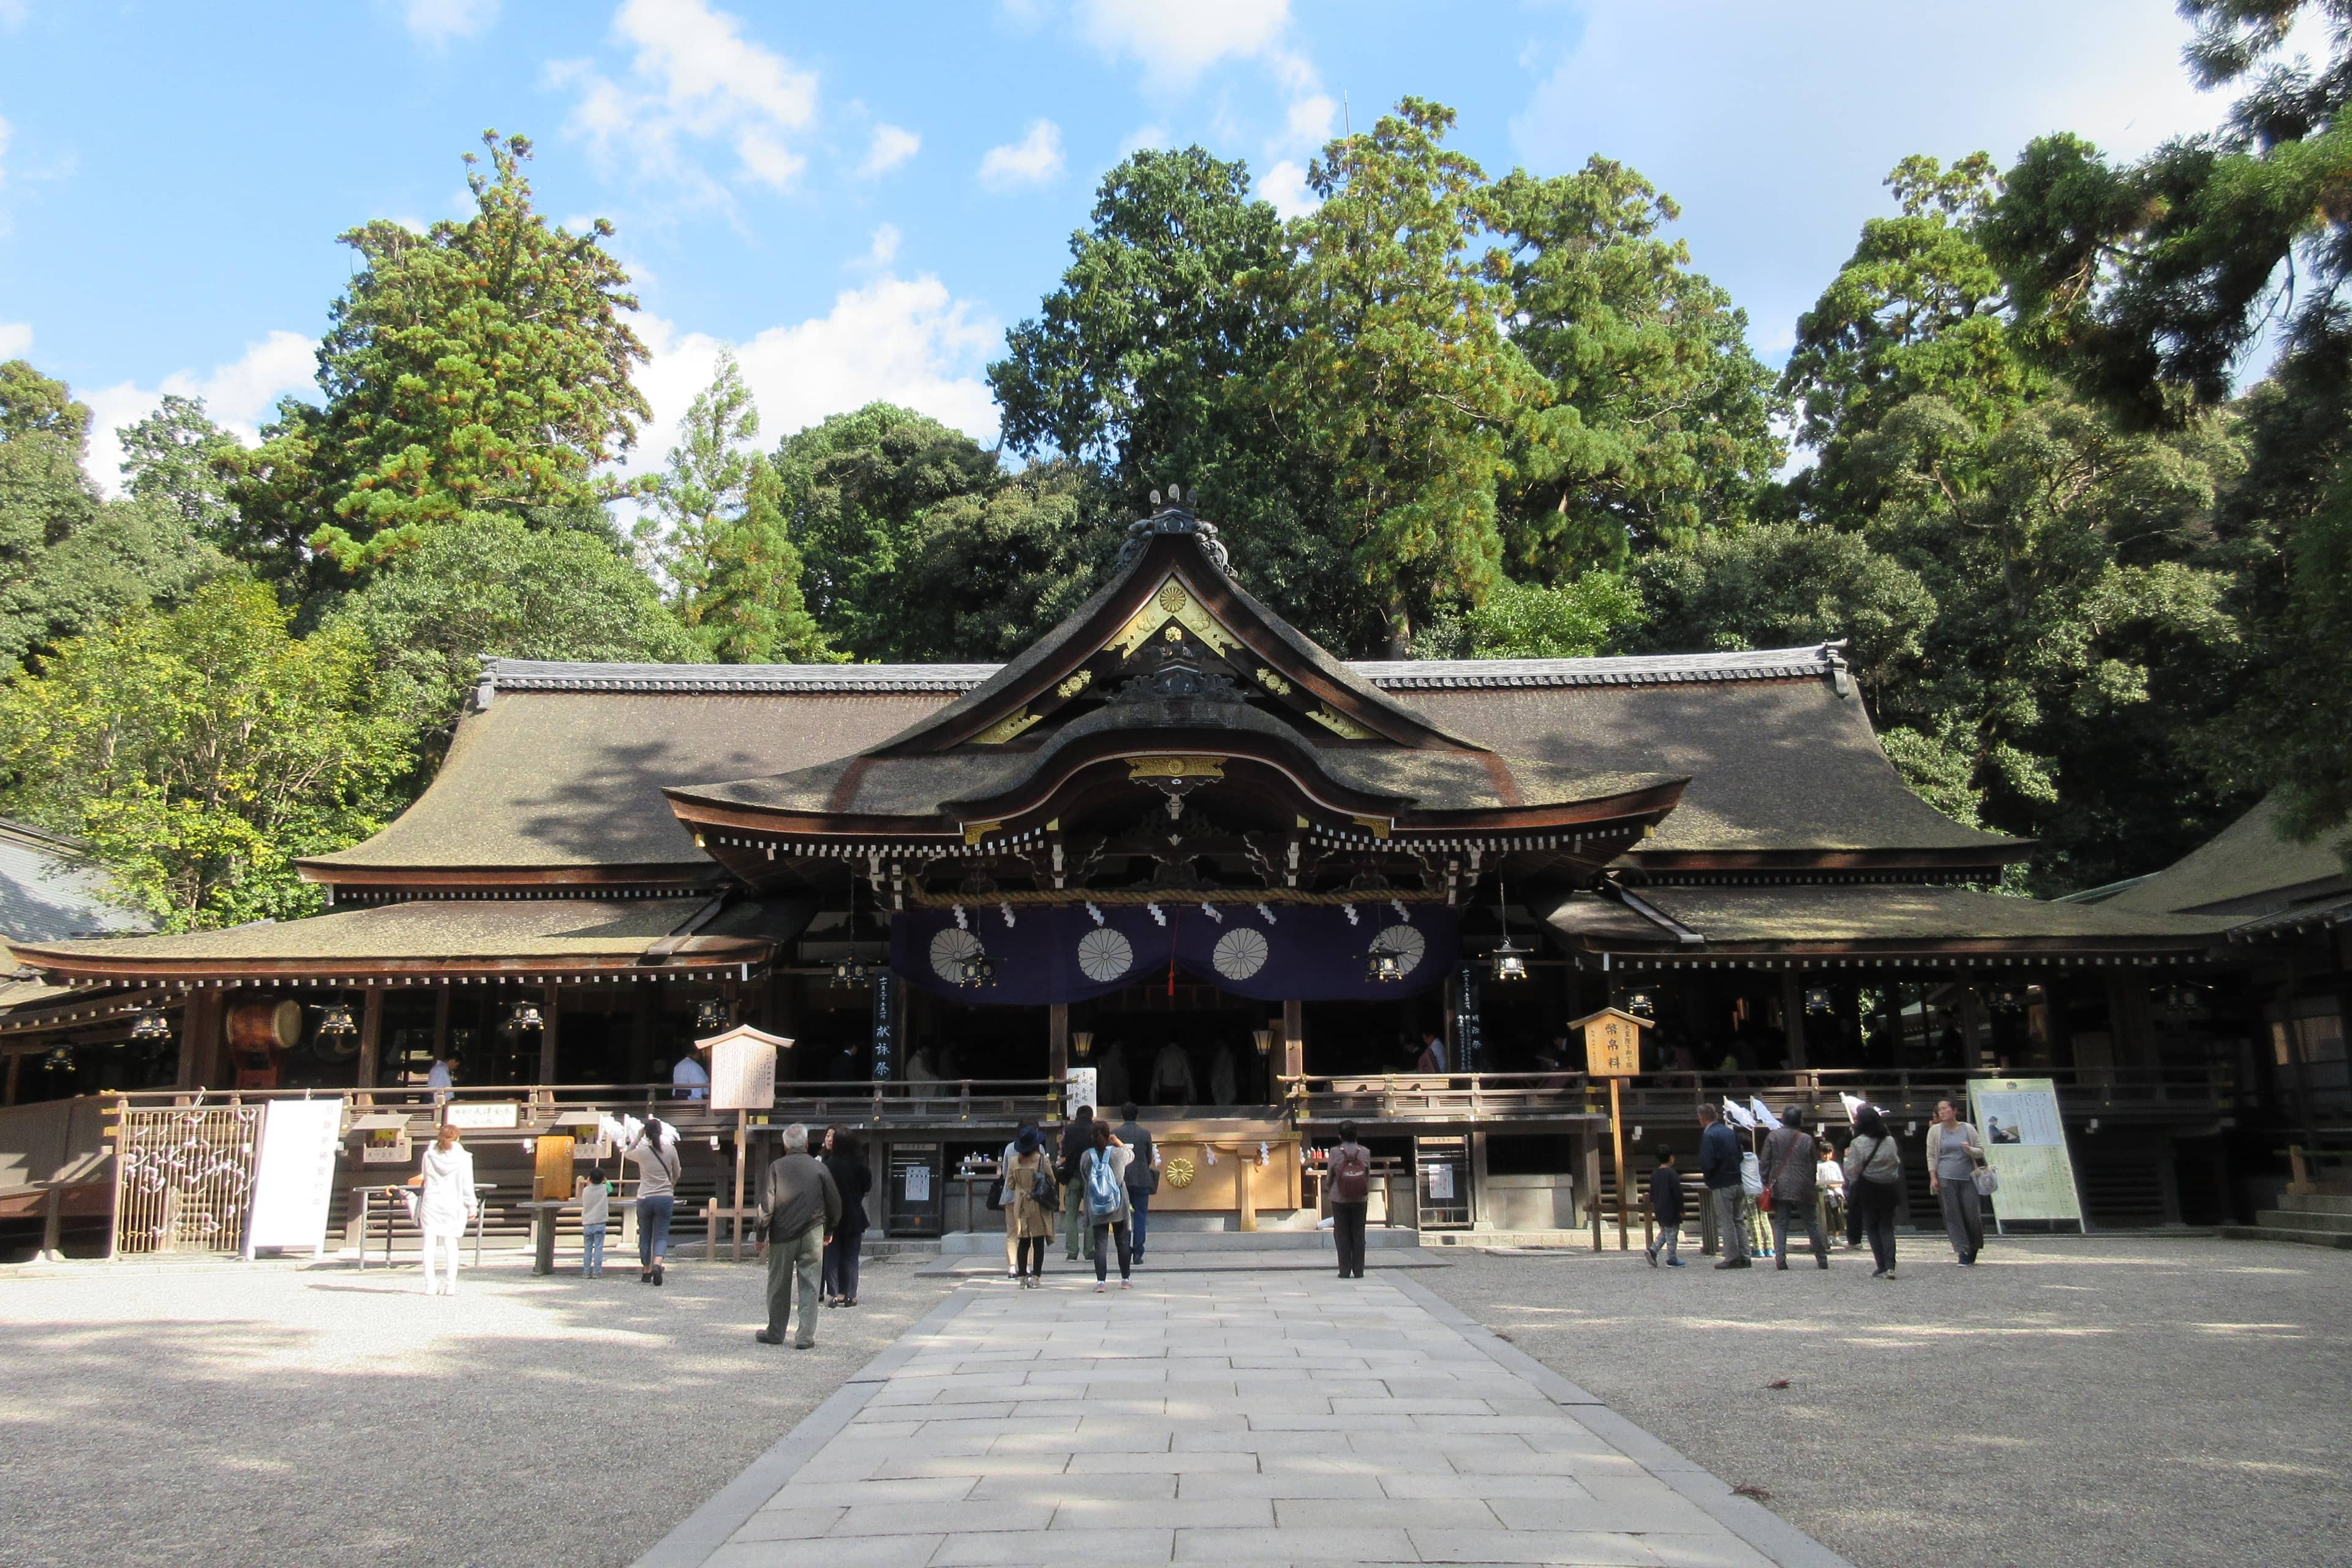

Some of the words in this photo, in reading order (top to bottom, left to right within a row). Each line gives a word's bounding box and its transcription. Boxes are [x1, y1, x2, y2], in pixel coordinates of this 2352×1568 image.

[873, 1025, 891, 1076] 献詠祭
[1472, 1014, 1482, 1049] 明治祭
[1605, 1022, 1621, 1069] 幣帛料
